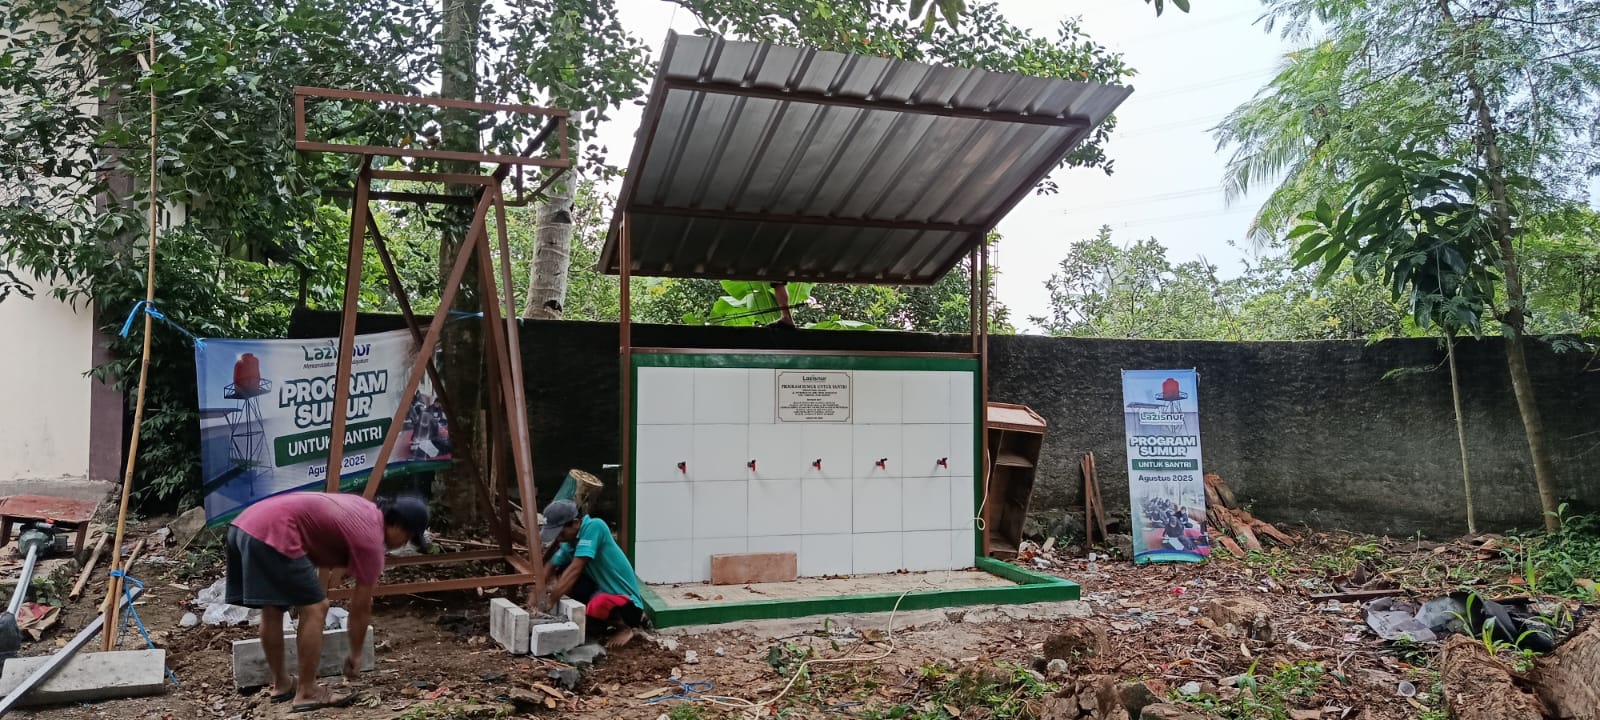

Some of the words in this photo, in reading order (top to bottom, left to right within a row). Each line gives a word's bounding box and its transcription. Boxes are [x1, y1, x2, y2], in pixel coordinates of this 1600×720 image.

[301, 341, 371, 361] Laziur
[1140, 411, 1183, 421] Lazisnur
[342, 425, 382, 446] ANTRI
[1130, 435, 1197, 446] PROGRAM
[1139, 446, 1187, 457] SUMUR
[343, 454, 366, 468] 2025
[1138, 474, 1171, 483] Agustus
[1172, 474, 1193, 482] 2025
